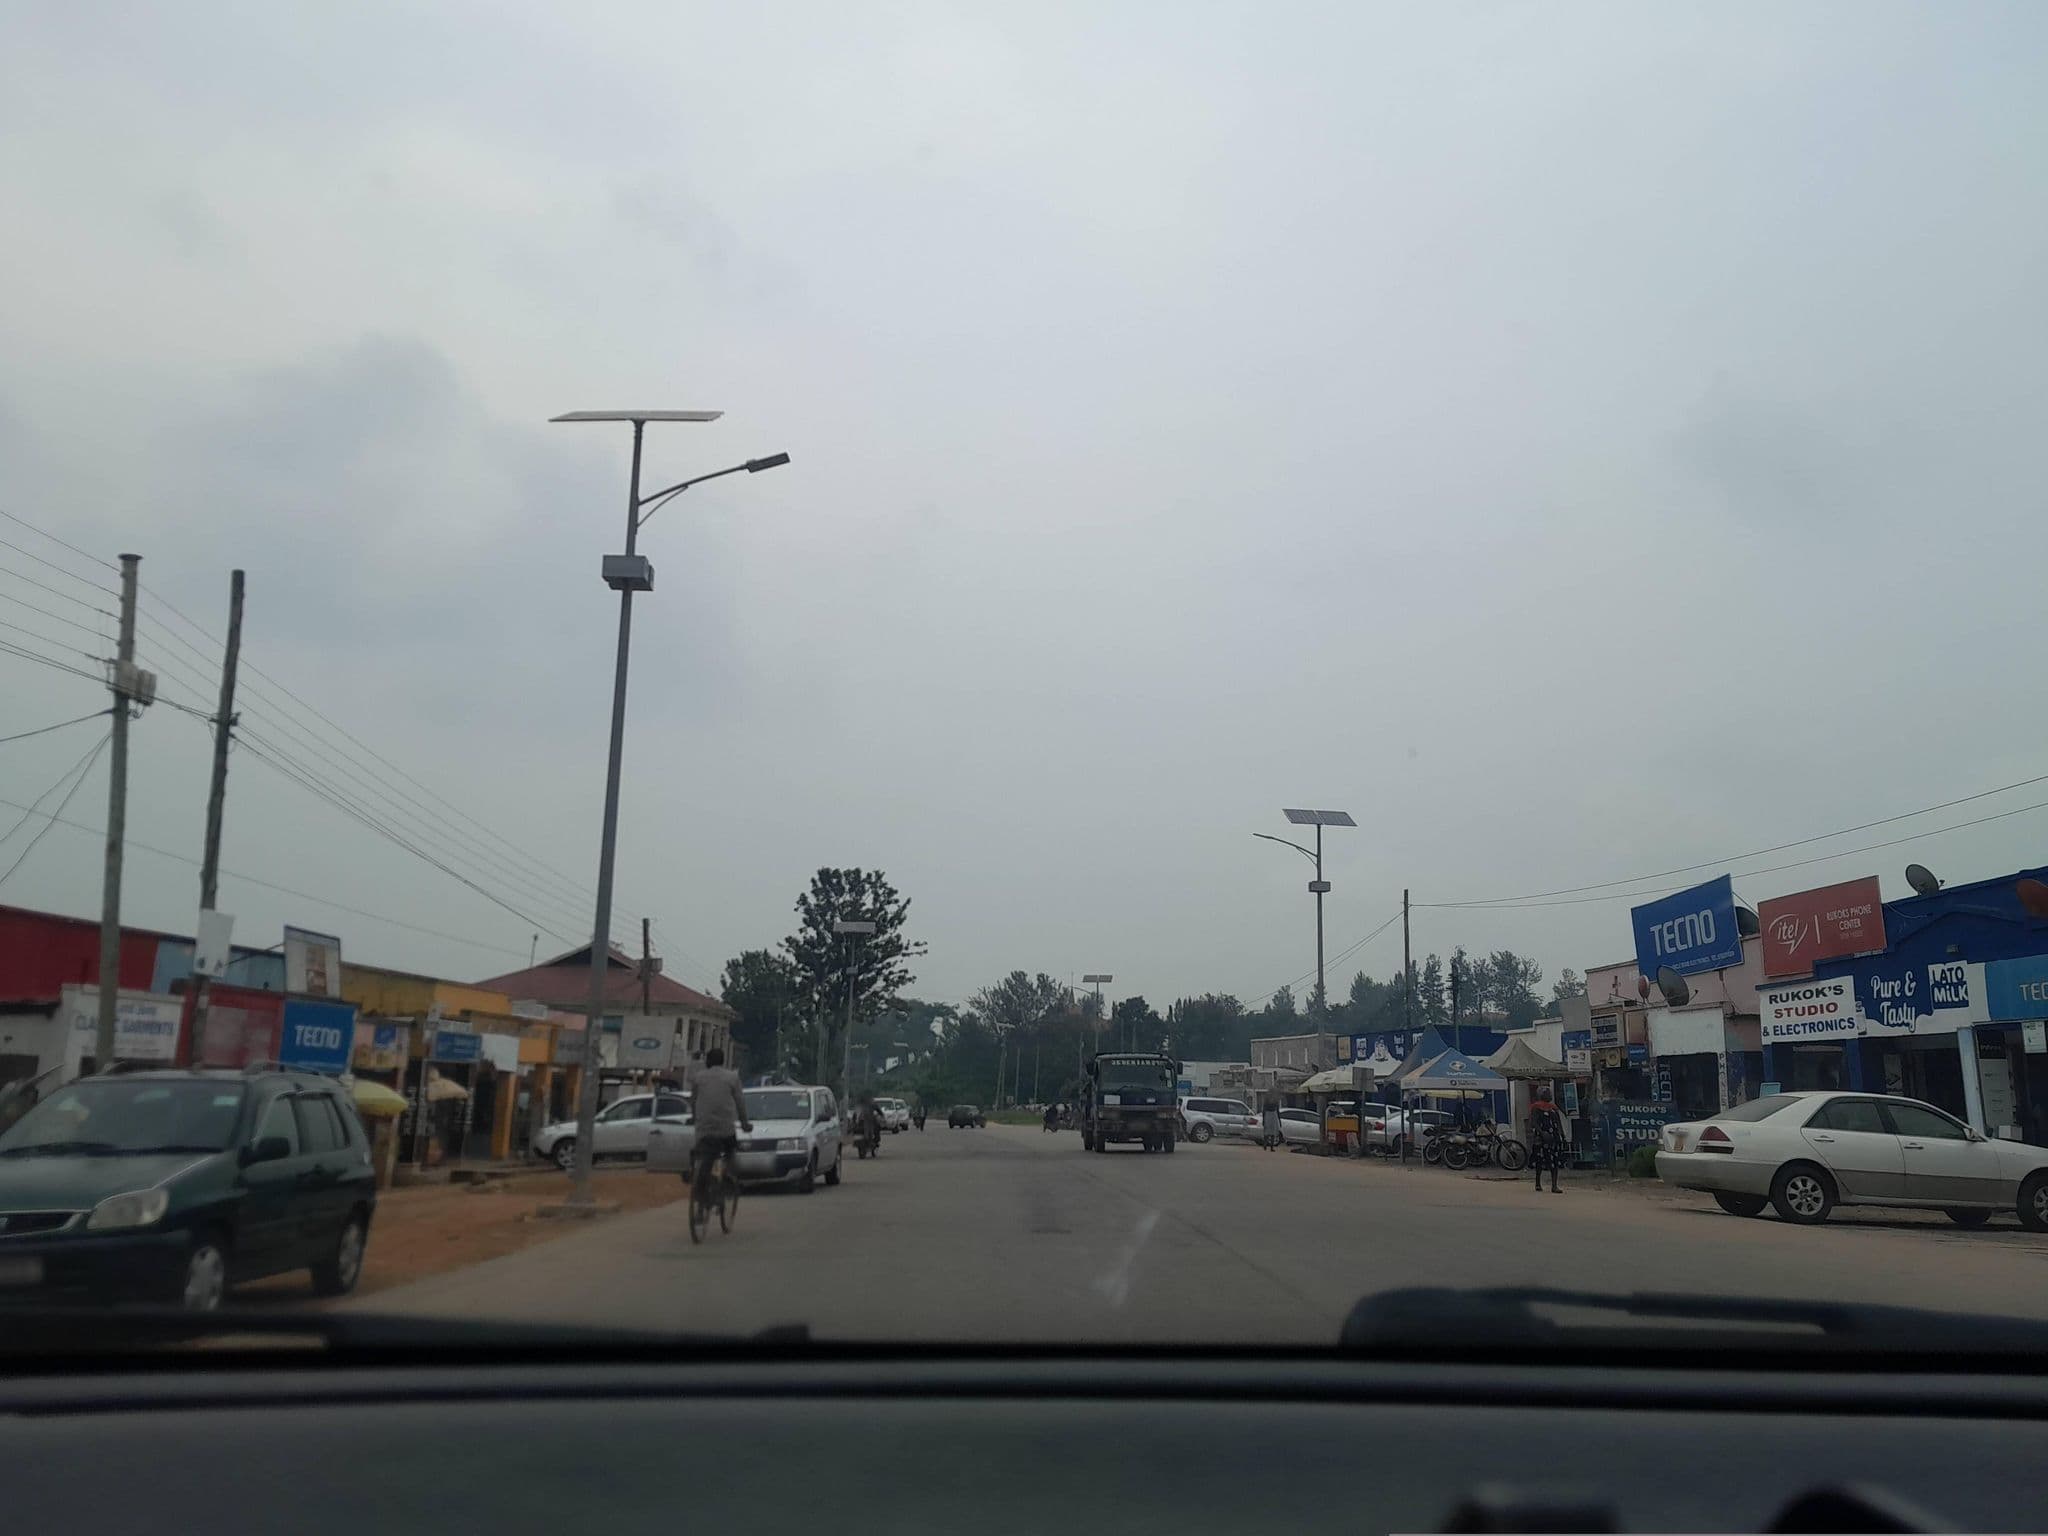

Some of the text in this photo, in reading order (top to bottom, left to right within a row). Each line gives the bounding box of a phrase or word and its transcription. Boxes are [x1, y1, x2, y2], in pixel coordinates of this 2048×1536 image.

[1649, 909, 1716, 957] TECNO
[1776, 918, 1799, 940] itel
[1870, 971, 1917, 999] Pure &
[1931, 966, 1965, 985] LATO
[1768, 984, 1844, 1005] RUKOK'S
[1773, 1002, 1839, 1019] STUDIO
[1879, 1001, 1916, 1033] Tasty
[294, 1025, 341, 1049] TECNO
[1762, 1017, 1855, 1037] & ELECTRONICS
[1619, 1105, 1668, 1114] RUKOK'S
[1620, 1117, 1666, 1126] Photo
